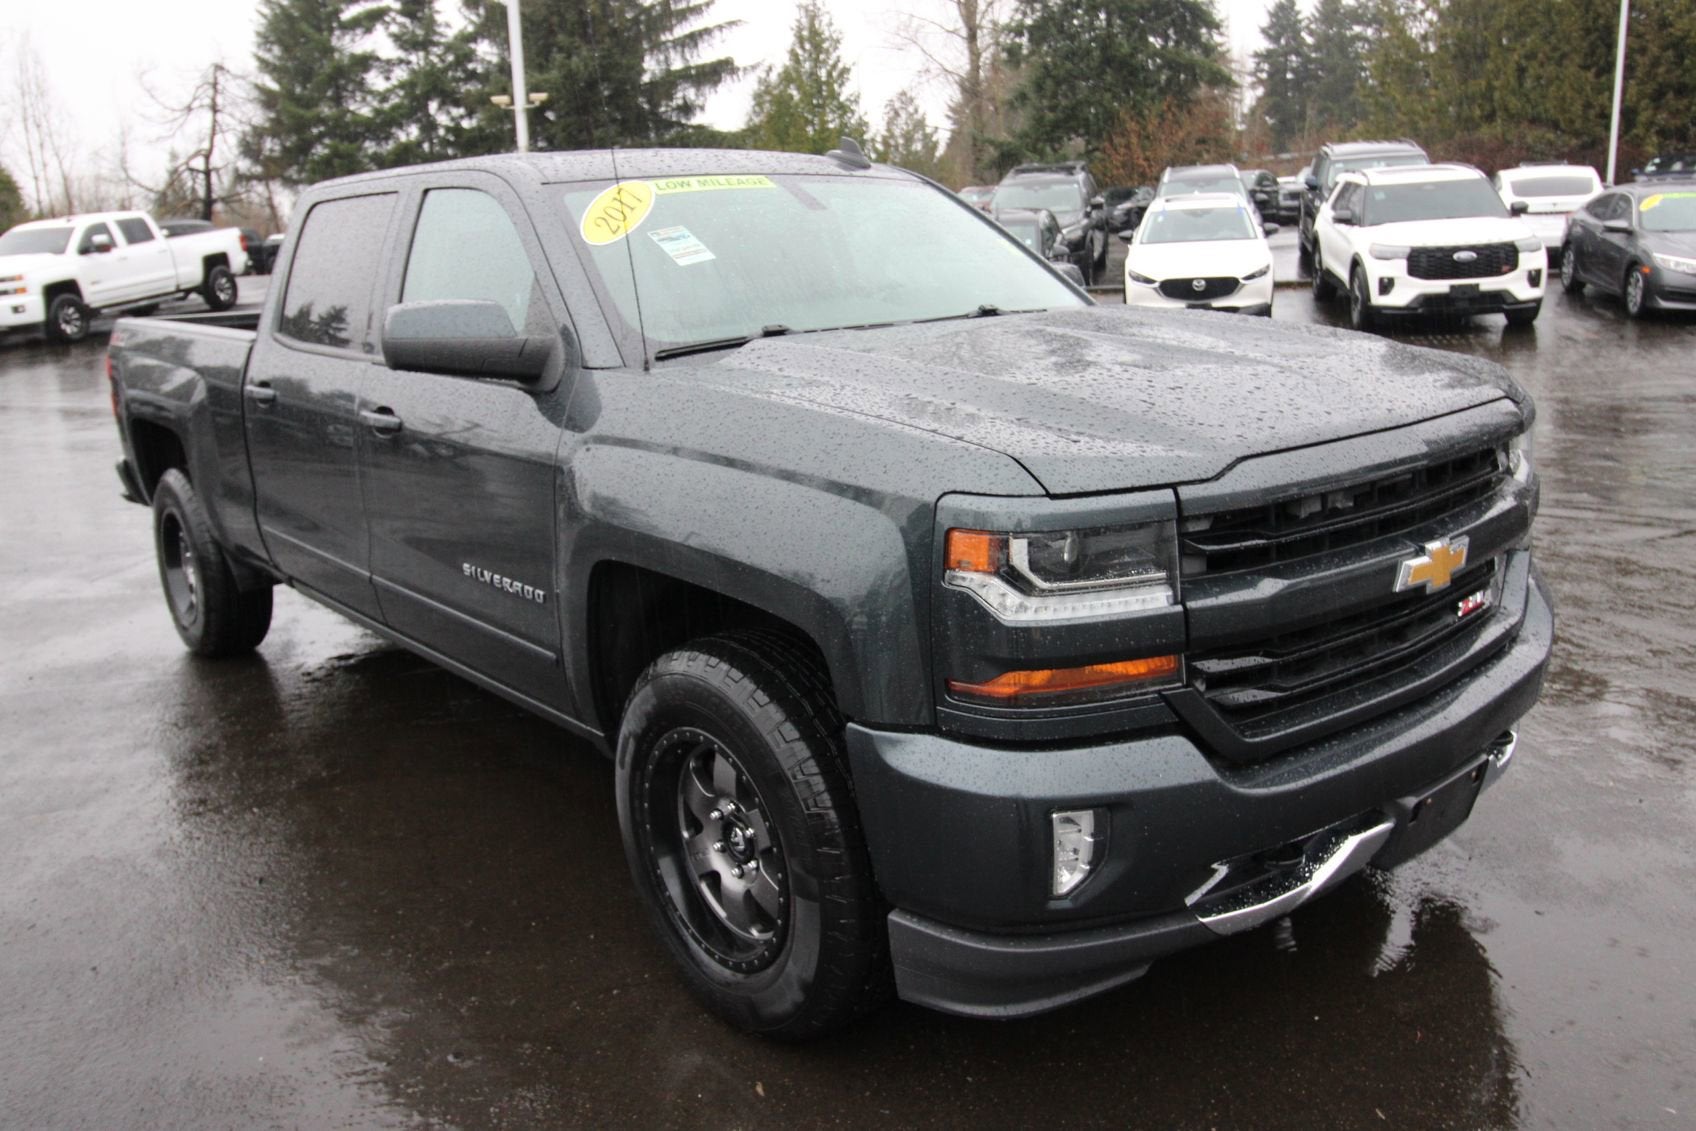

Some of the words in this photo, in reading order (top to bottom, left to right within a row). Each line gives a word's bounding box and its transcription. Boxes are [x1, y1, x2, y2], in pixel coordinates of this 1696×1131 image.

[655, 179, 692, 192] LOW
[697, 176, 769, 188] MILEAGE
[594, 186, 644, 236] 2017
[462, 562, 547, 605] SILVERADO
